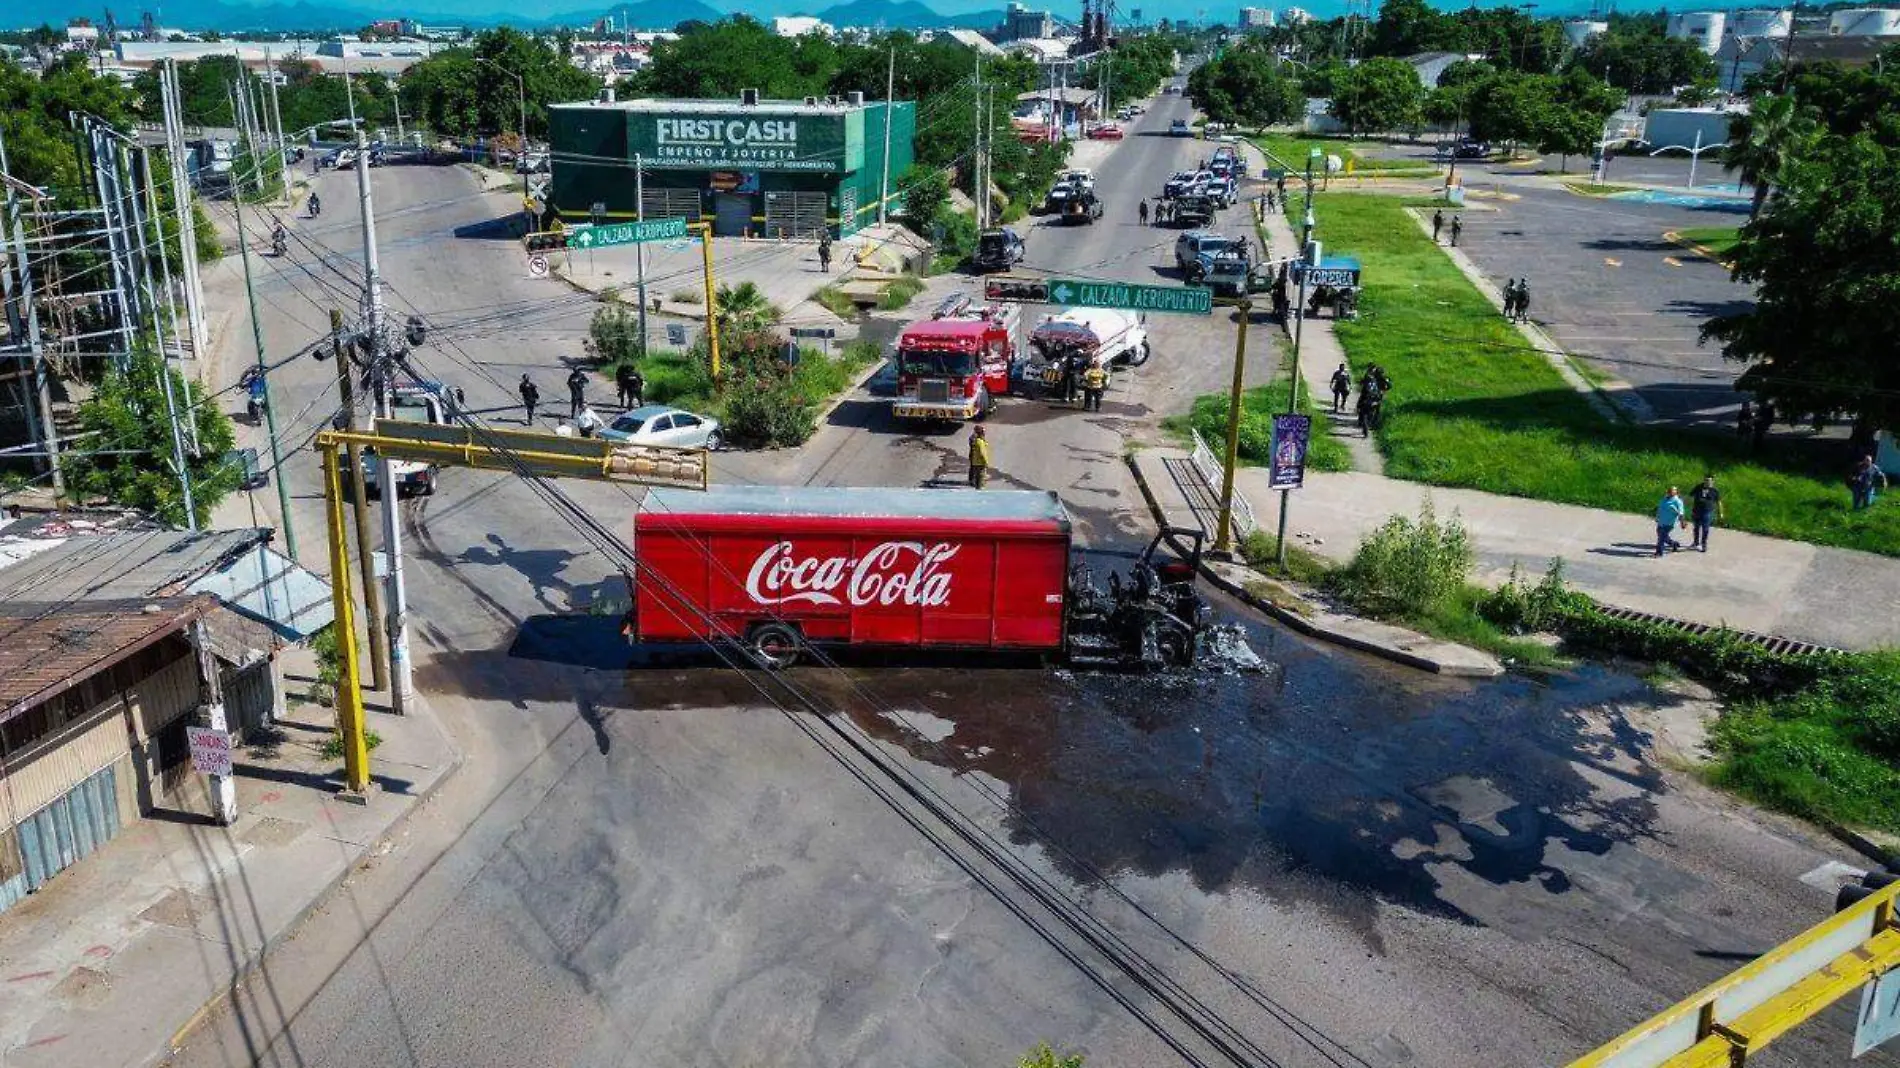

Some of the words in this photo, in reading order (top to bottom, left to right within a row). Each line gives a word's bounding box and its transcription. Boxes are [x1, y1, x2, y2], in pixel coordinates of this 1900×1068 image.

[720, 148, 727, 158] Y
[598, 226, 634, 244] CALZADA
[636, 221, 683, 240] AEROPUERTO
[1080, 285, 1130, 306] CALZADA
[1134, 288, 1208, 311] AEROPUERTO
[745, 540, 962, 607] Coca-Cola
